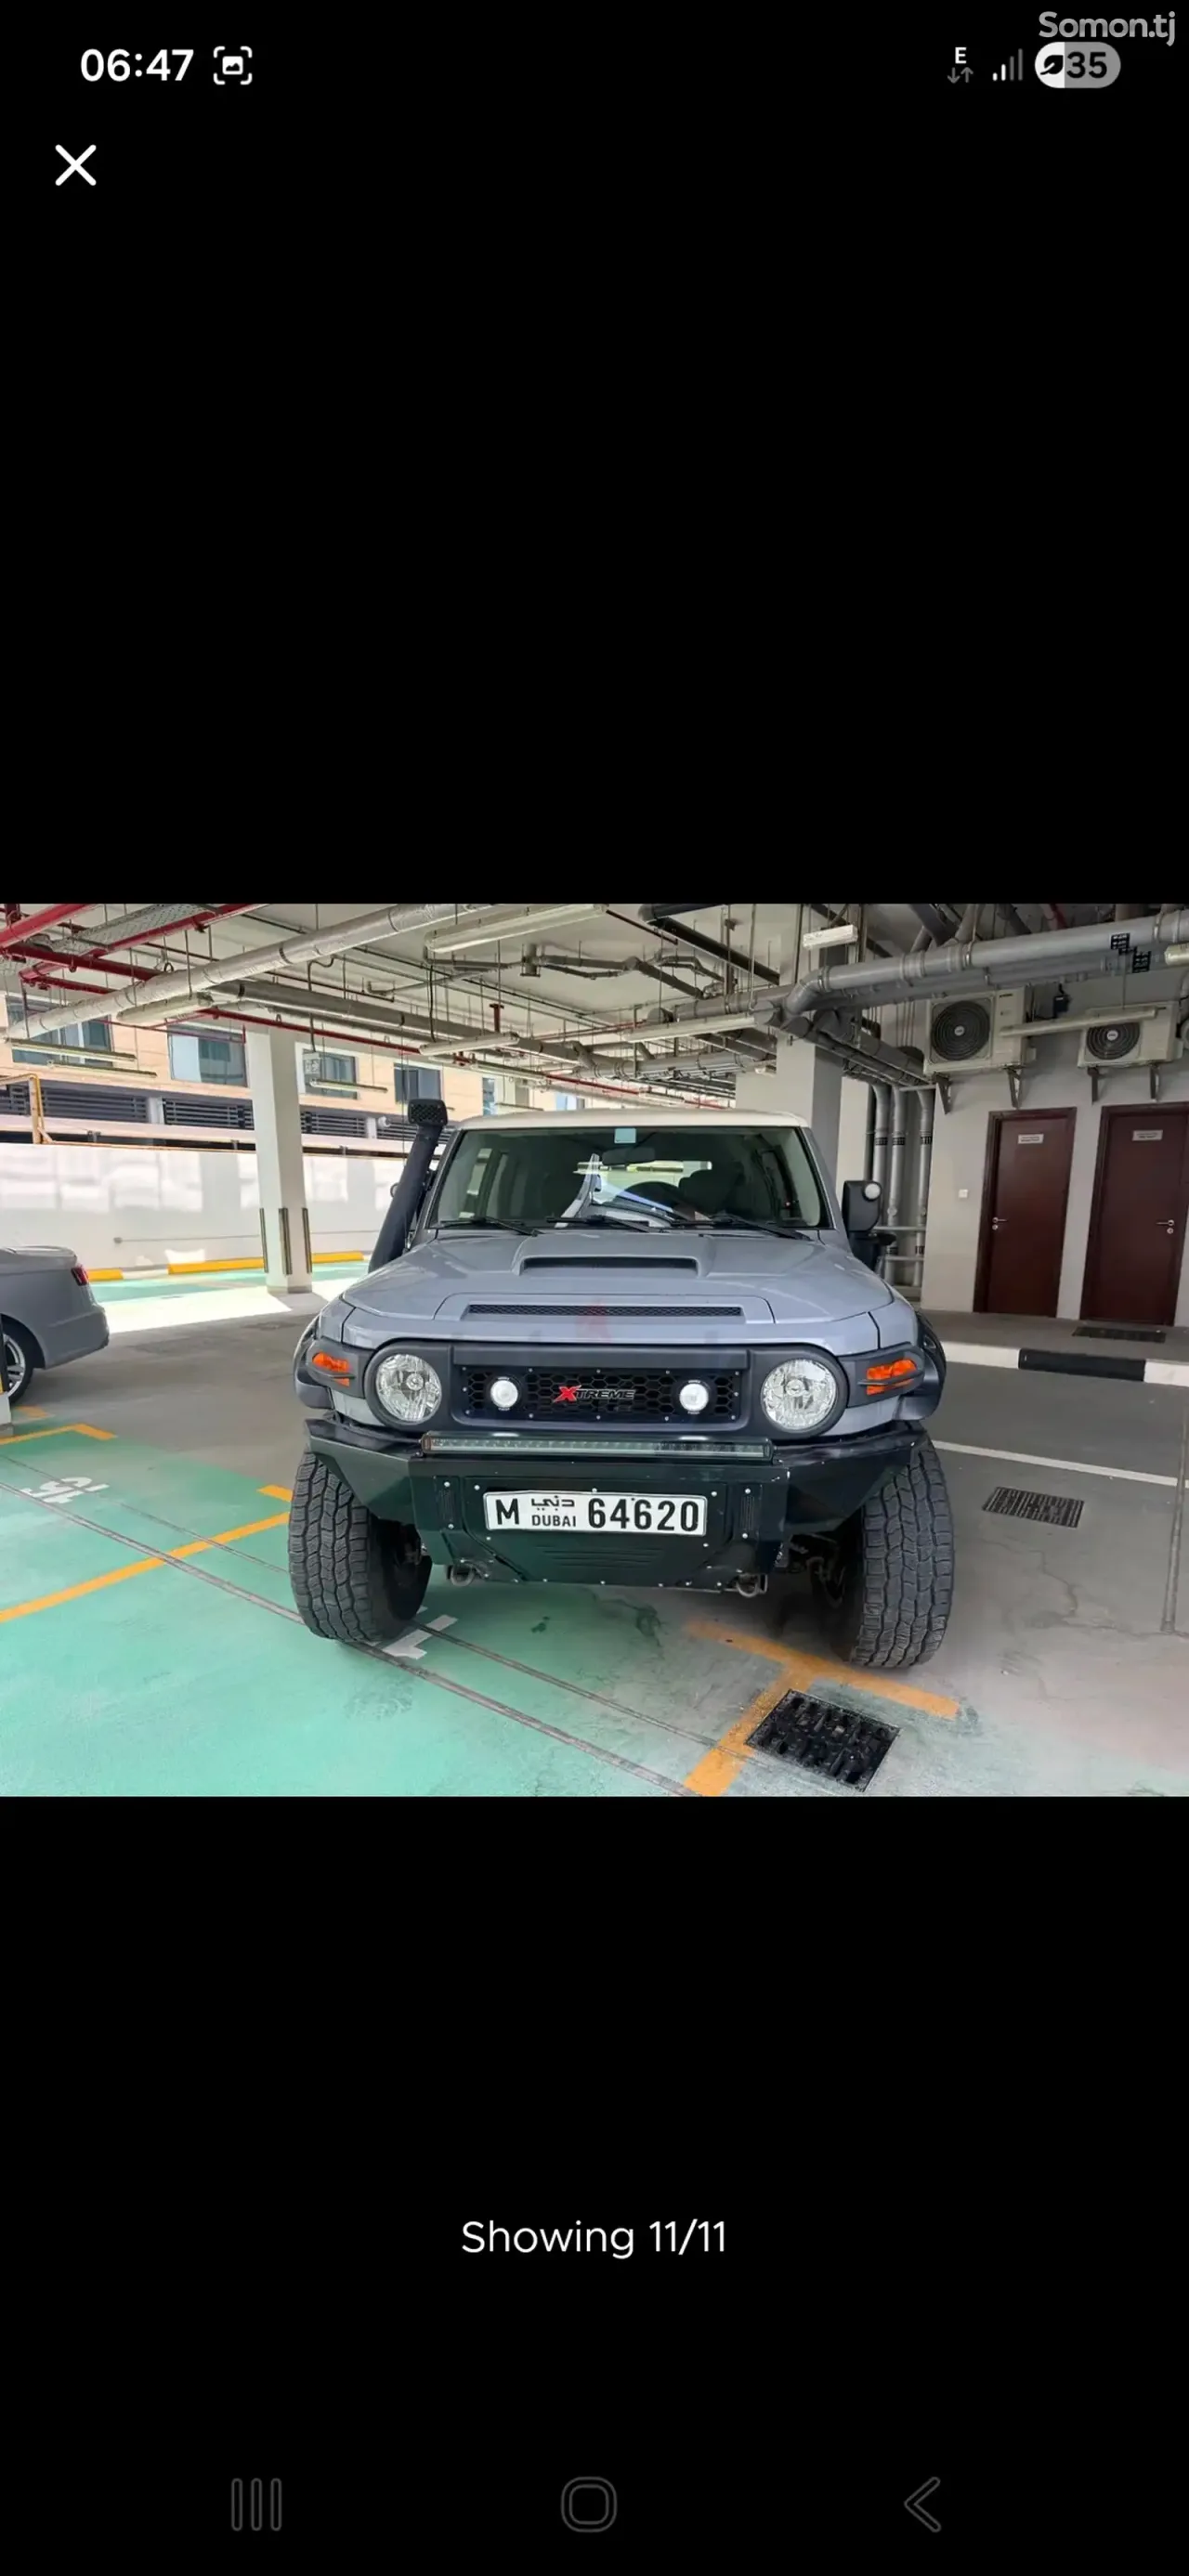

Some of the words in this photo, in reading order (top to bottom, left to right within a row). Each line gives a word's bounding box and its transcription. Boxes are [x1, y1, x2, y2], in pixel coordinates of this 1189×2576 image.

[553, 1385, 636, 1402] XTREME
[495, 1498, 519, 1525] M
[588, 1498, 699, 1531] 64620
[531, 1515, 576, 1527] DUBAI
